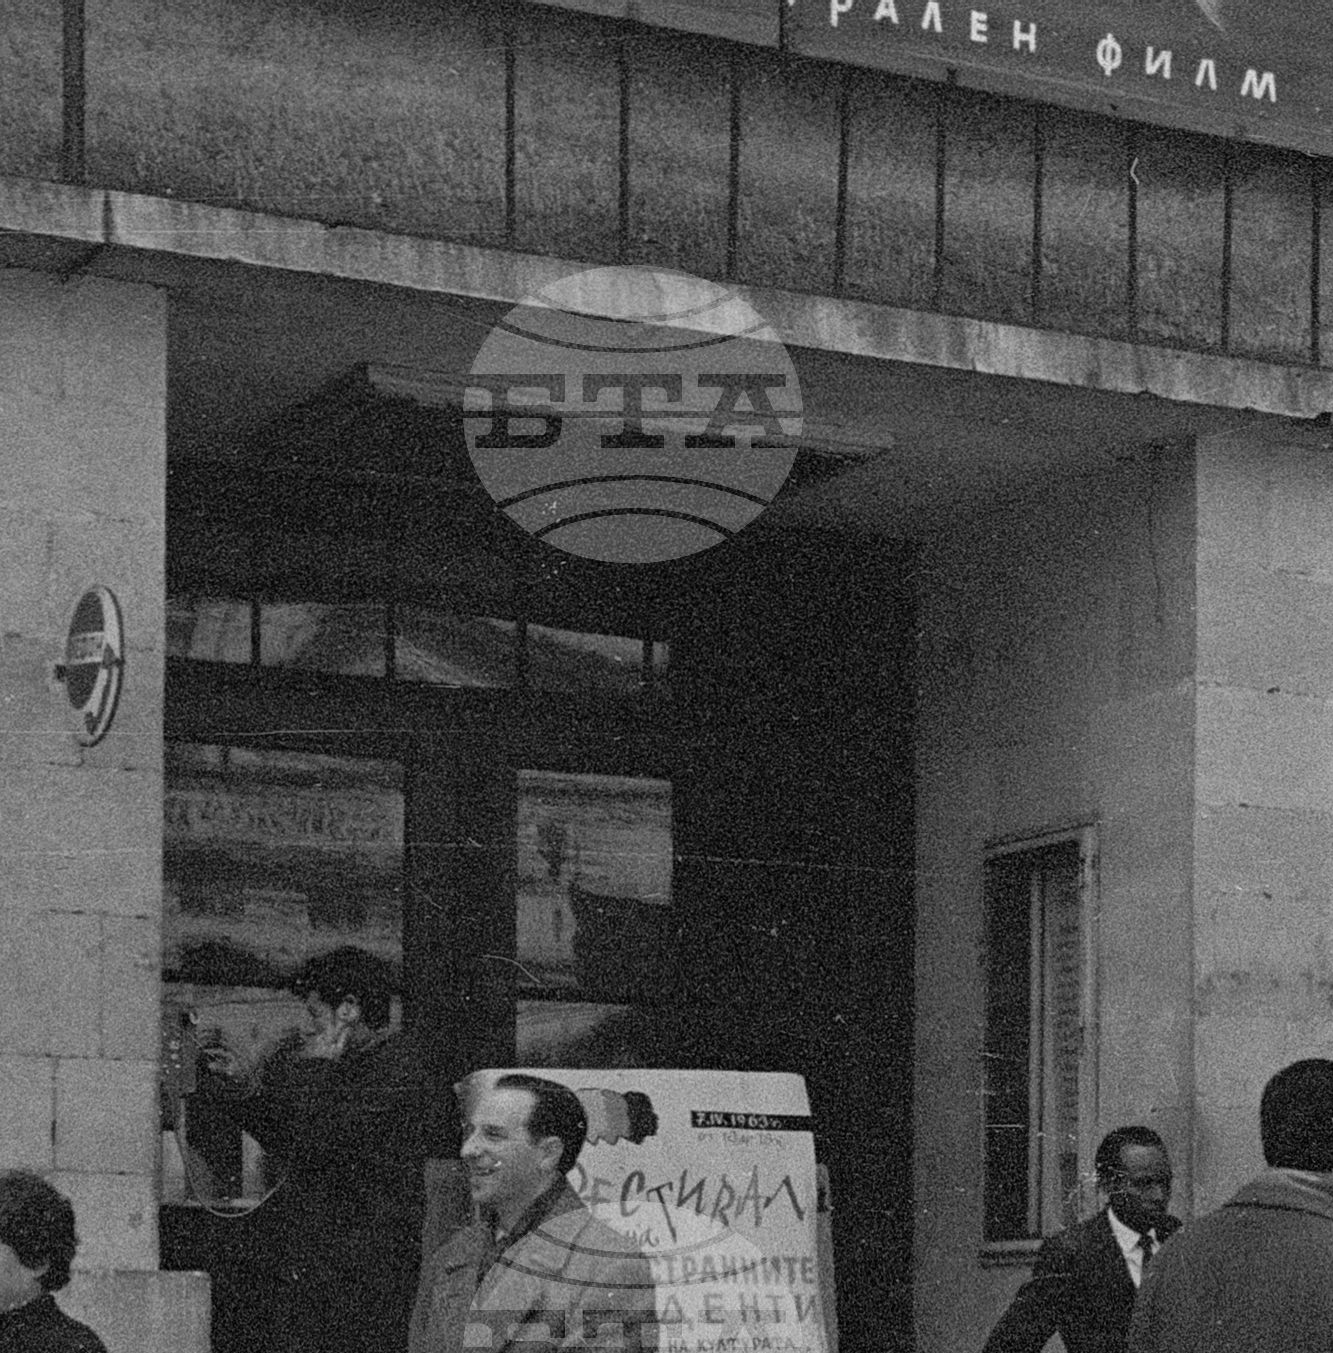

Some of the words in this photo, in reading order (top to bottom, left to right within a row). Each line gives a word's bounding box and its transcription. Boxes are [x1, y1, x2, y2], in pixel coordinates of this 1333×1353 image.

[789, 0, 1037, 53] РАЛЕН
[1096, 33, 1278, 103] ФИЛМ
[652, 1255, 817, 1286] СТРАННИТЕ
[660, 1293, 819, 1329] ДЕНТИ
